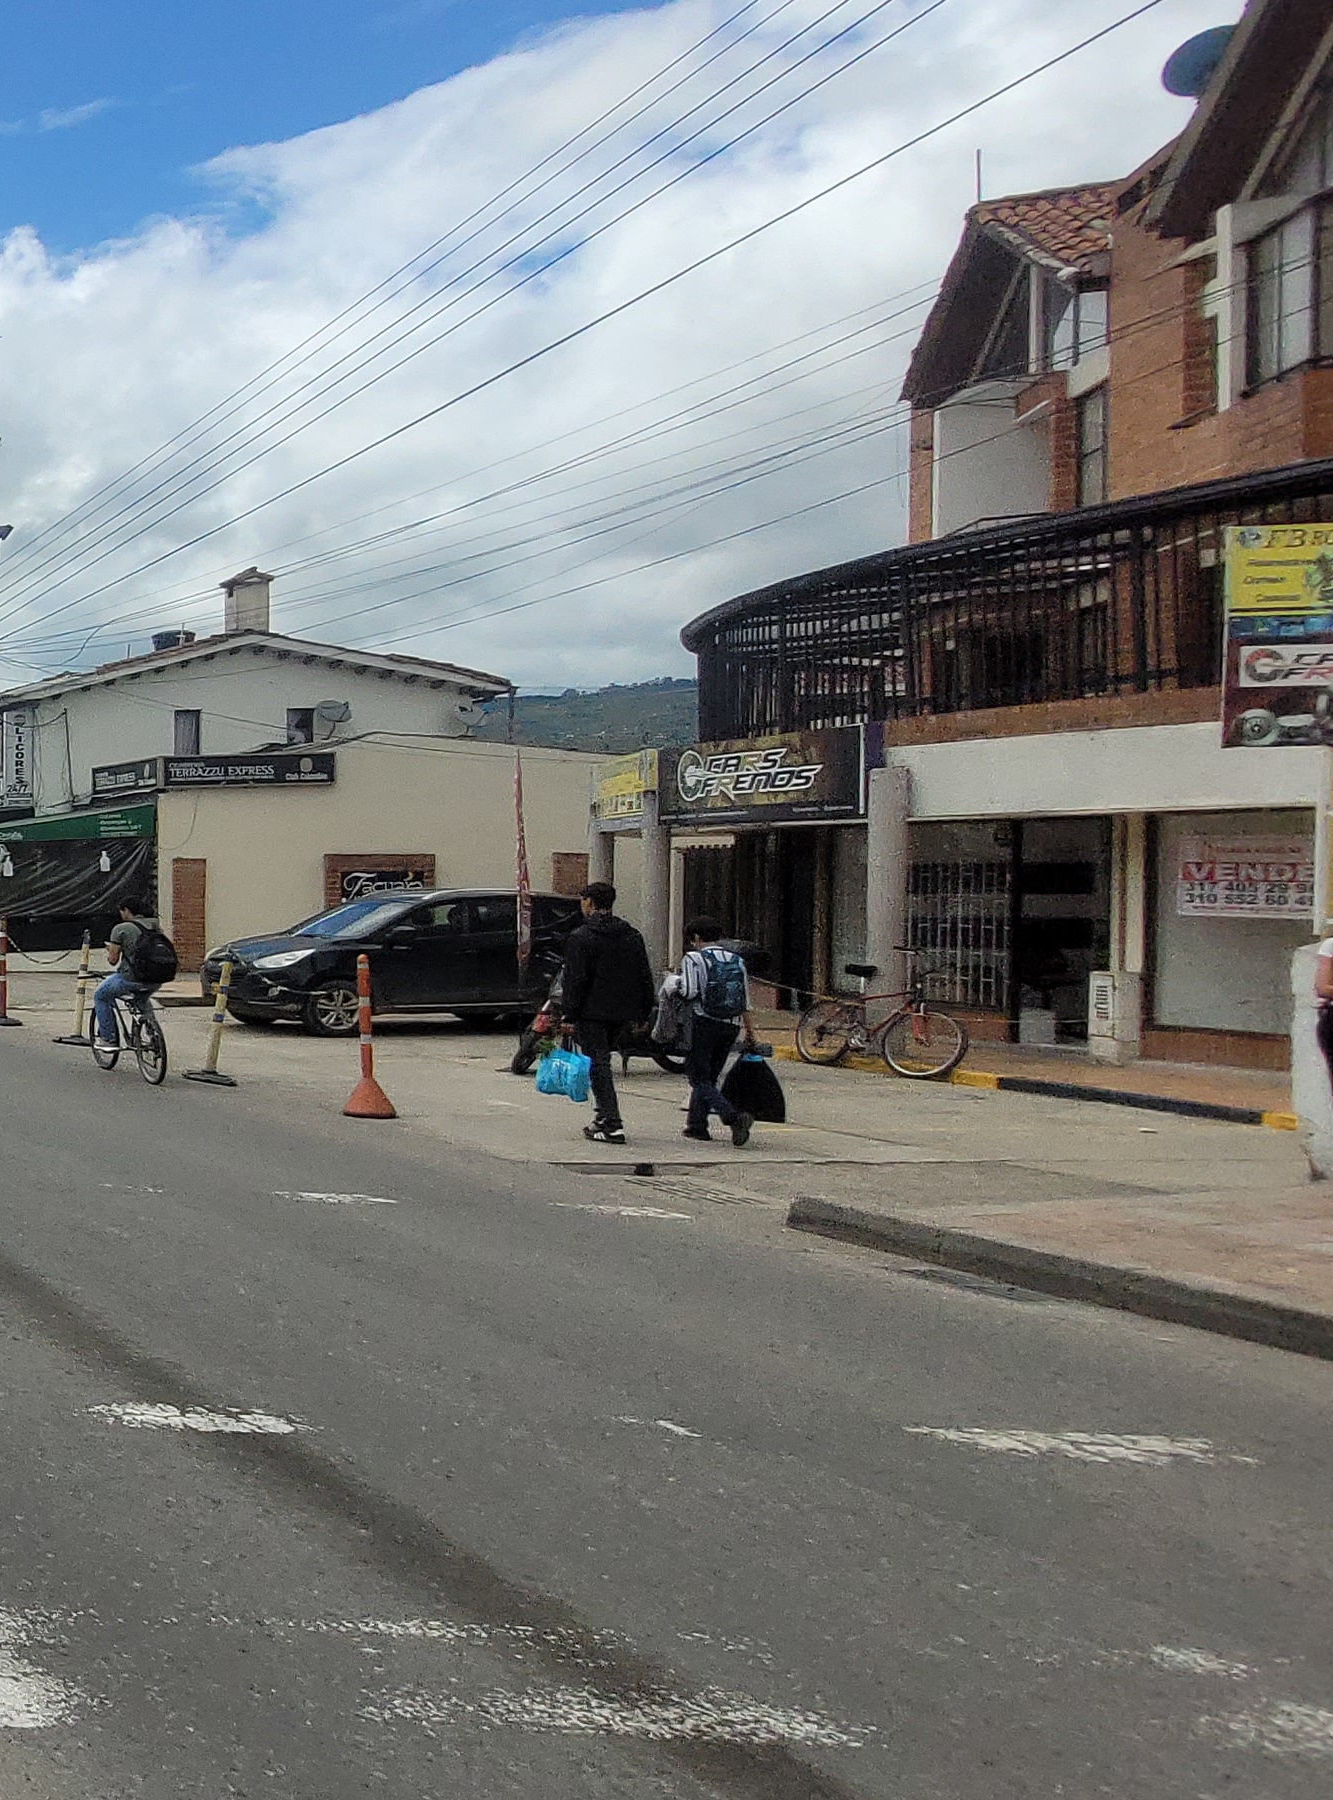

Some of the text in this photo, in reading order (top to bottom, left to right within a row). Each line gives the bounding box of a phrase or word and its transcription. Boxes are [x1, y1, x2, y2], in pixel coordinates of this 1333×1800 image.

[14, 727, 25, 785] LICORES
[227, 764, 275, 776] EXPRESS
[698, 764, 824, 799] FRENOS
